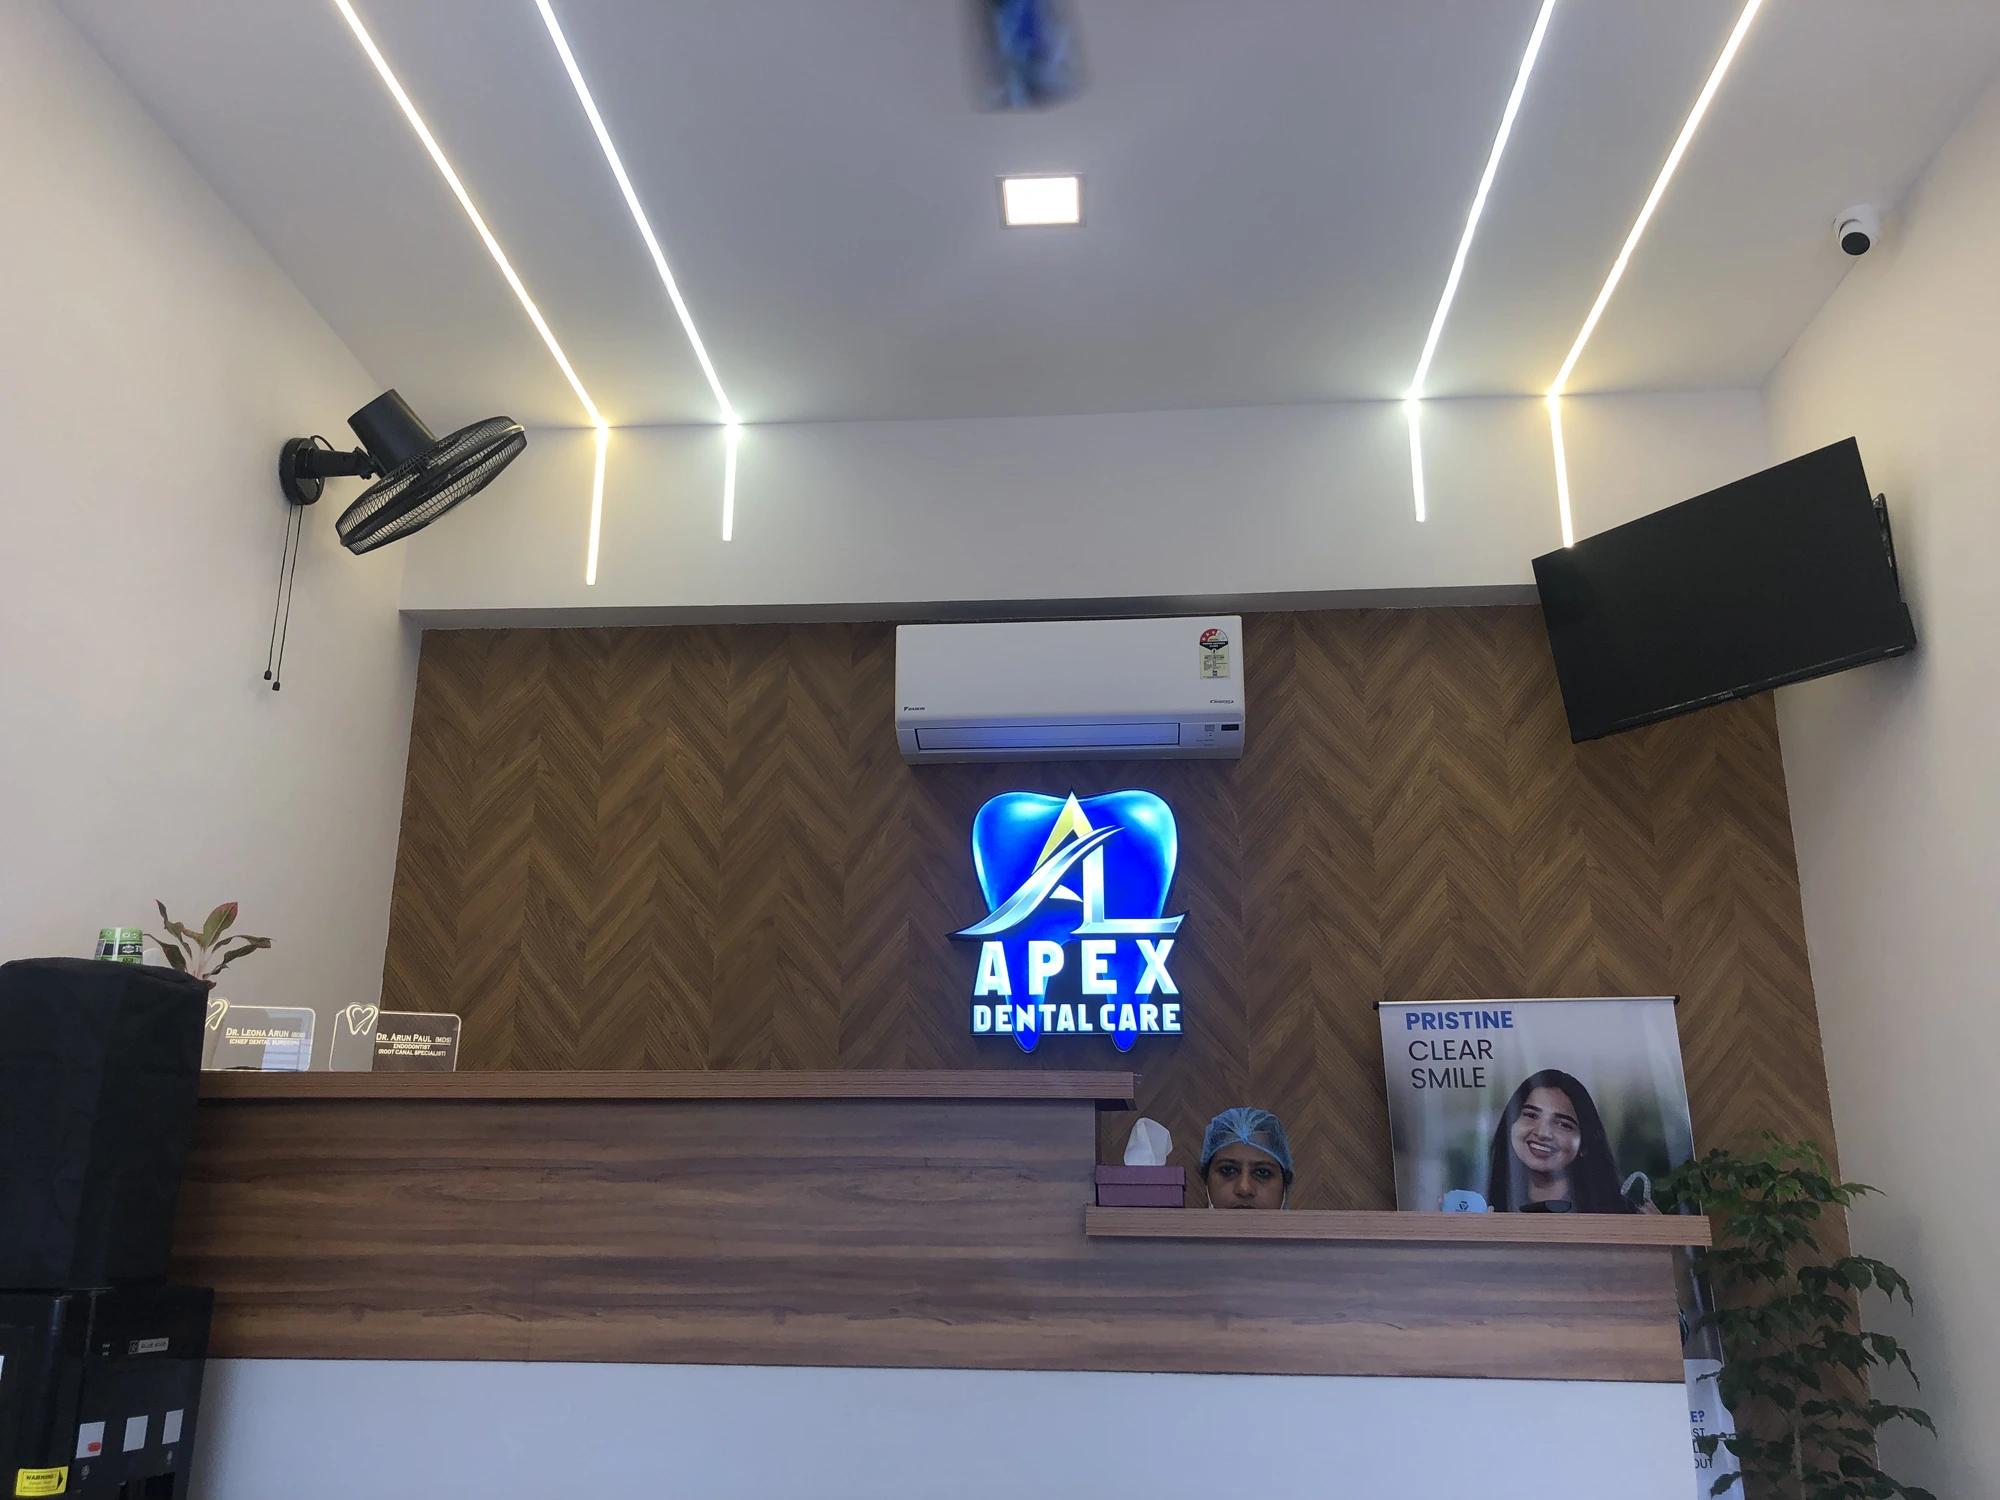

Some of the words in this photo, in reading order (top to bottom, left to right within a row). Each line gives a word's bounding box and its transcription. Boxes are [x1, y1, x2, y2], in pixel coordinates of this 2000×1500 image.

[973, 939, 1180, 996] APEX
[973, 1003, 1093, 1033] DENTAL
[1099, 1003, 1182, 1032] CARE
[1405, 1010, 1514, 1031] PRISTINE
[241, 1027, 266, 1037] LEONA
[267, 1028, 289, 1038] ARUN
[375, 1032, 389, 1041] DR.
[390, 1033, 412, 1042] ARUN
[412, 1034, 432, 1043] PAUL
[1408, 1038, 1494, 1061] CLEAR
[1410, 1067, 1487, 1089] SMILE
[1690, 1409, 1705, 1423] E?
[1691, 1427, 1705, 1438] ST
